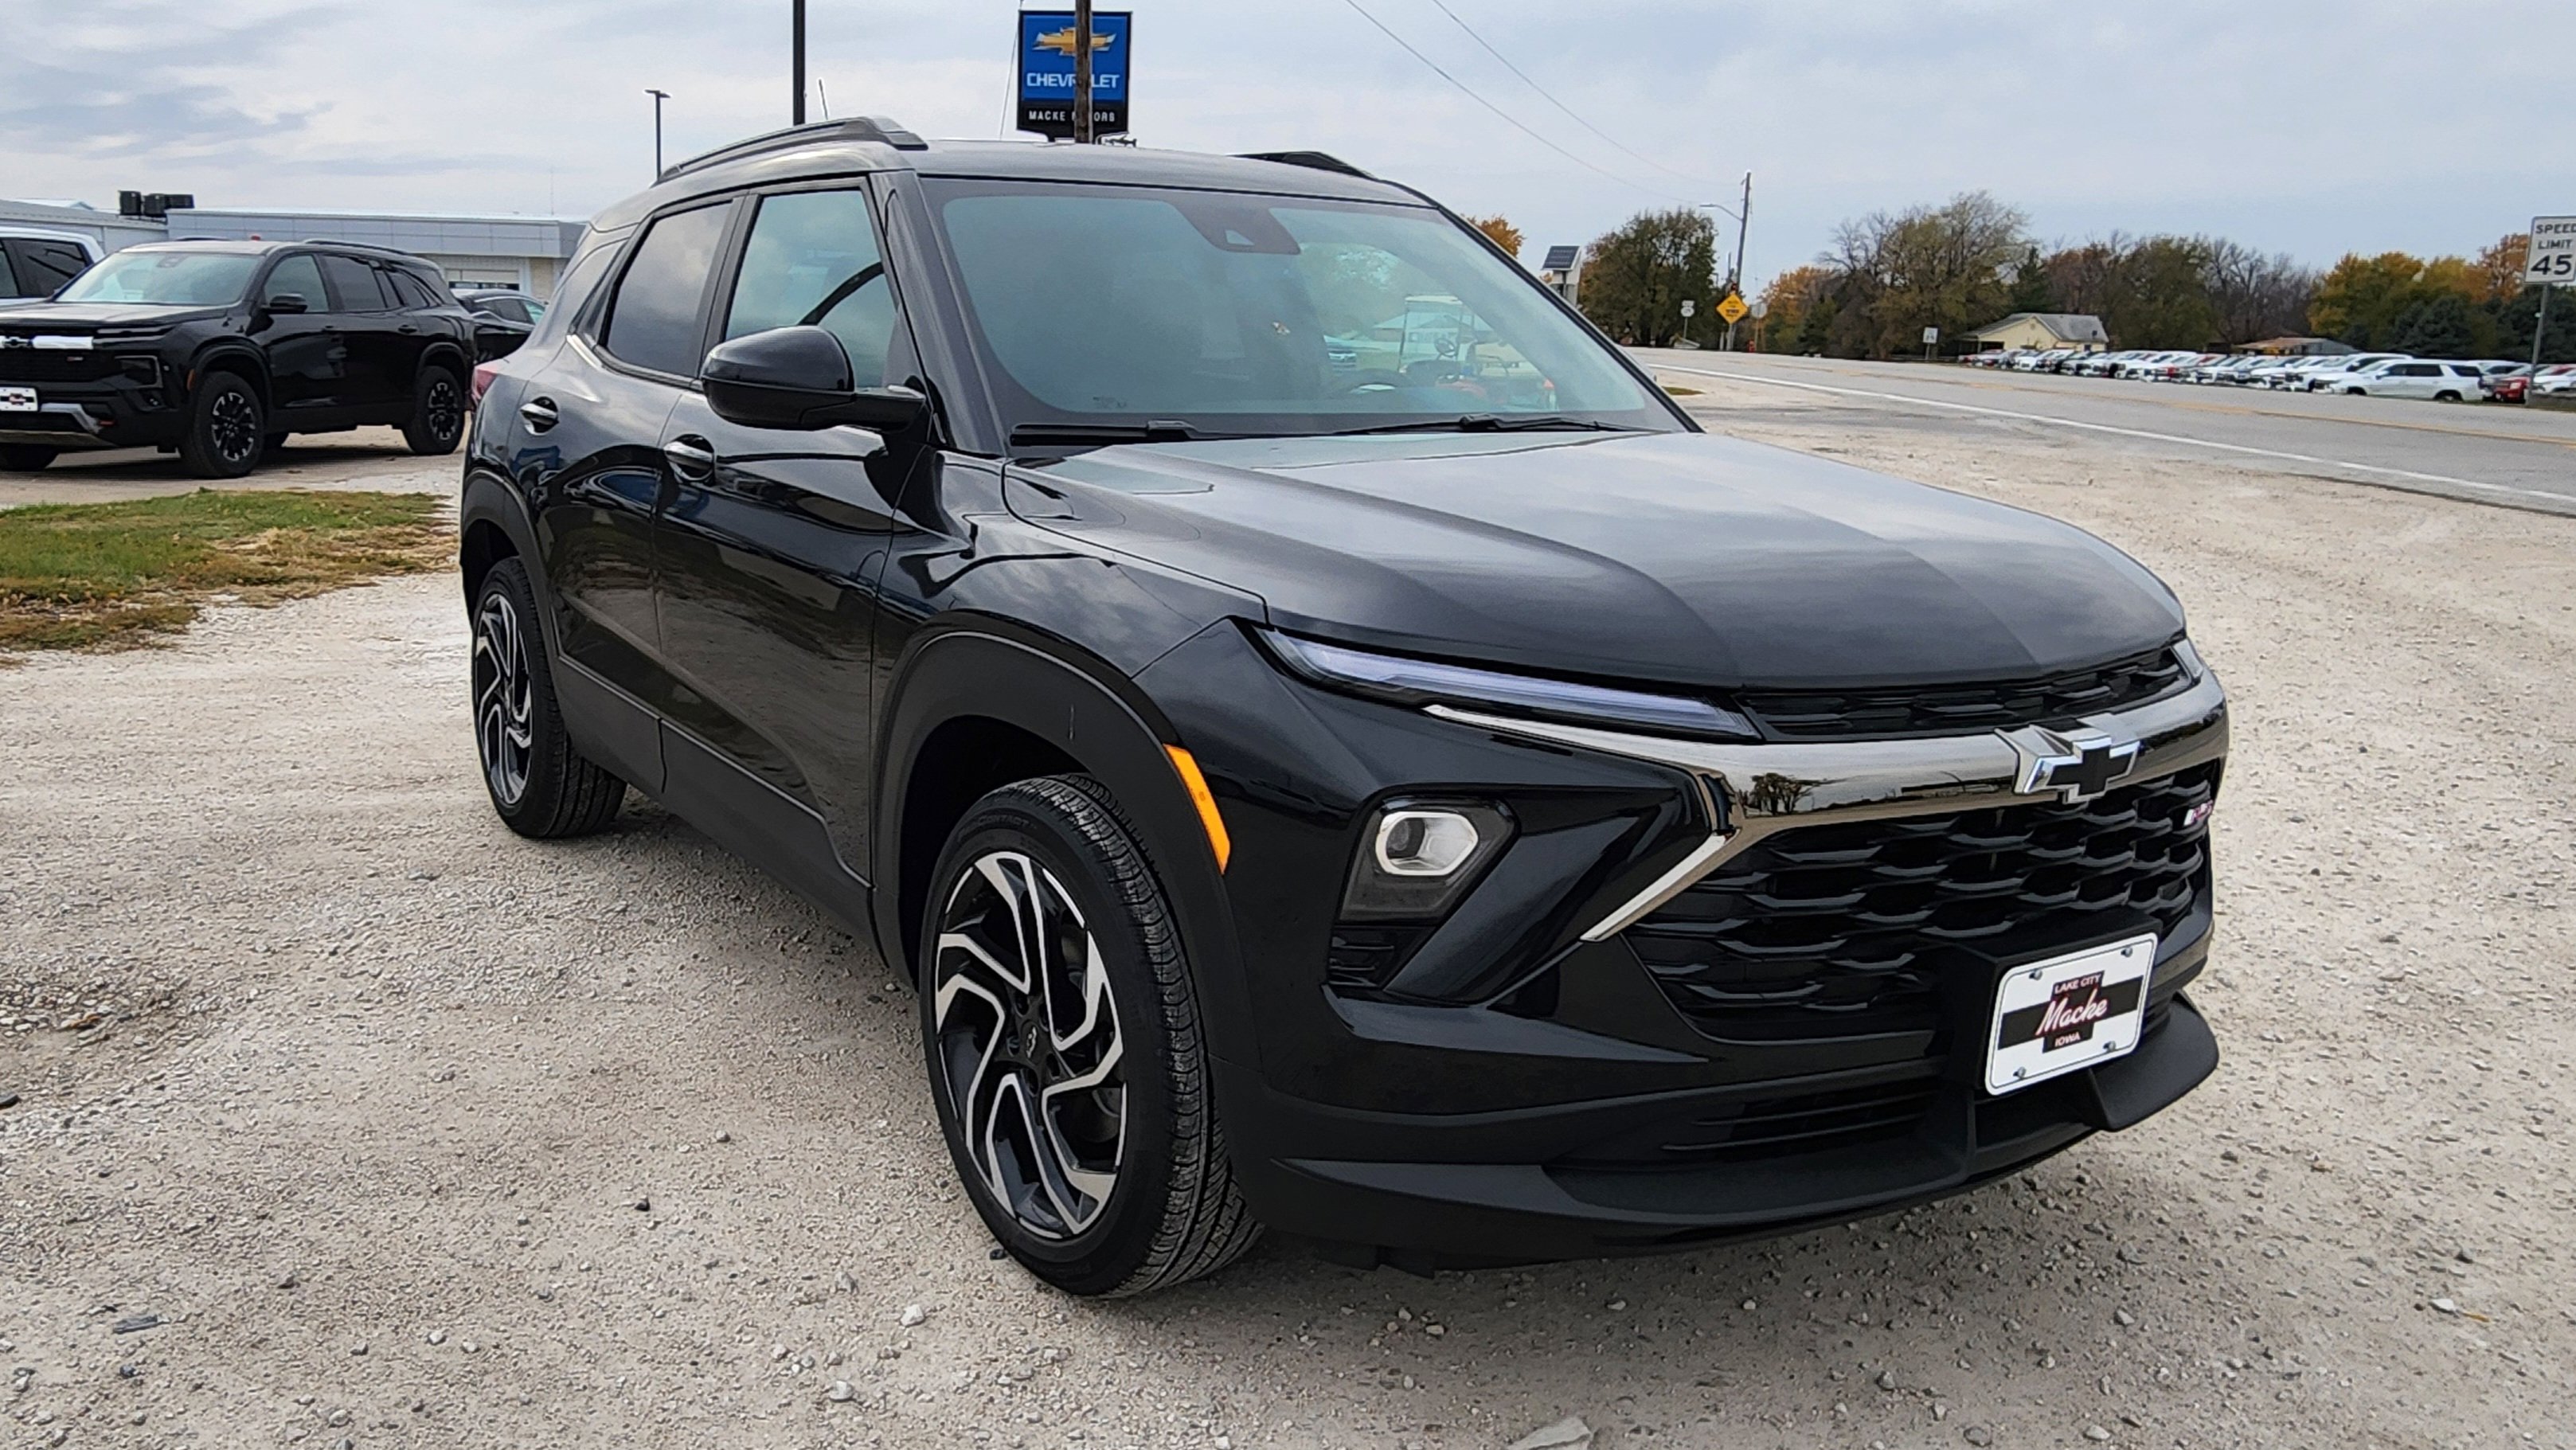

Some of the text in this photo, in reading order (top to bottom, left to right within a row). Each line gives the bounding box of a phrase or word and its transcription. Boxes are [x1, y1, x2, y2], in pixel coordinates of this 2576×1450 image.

[1026, 73, 1120, 88] CHEVRLET
[1029, 111, 1065, 121] MACKE
[2535, 224, 2576, 234] SPEED
[2538, 239, 2573, 249] LIMIT
[2531, 254, 2573, 276] 45
[2055, 974, 2101, 994] LAKE CITY
[2035, 987, 2108, 1036] Macke
[2054, 1031, 2082, 1047] IOWA
